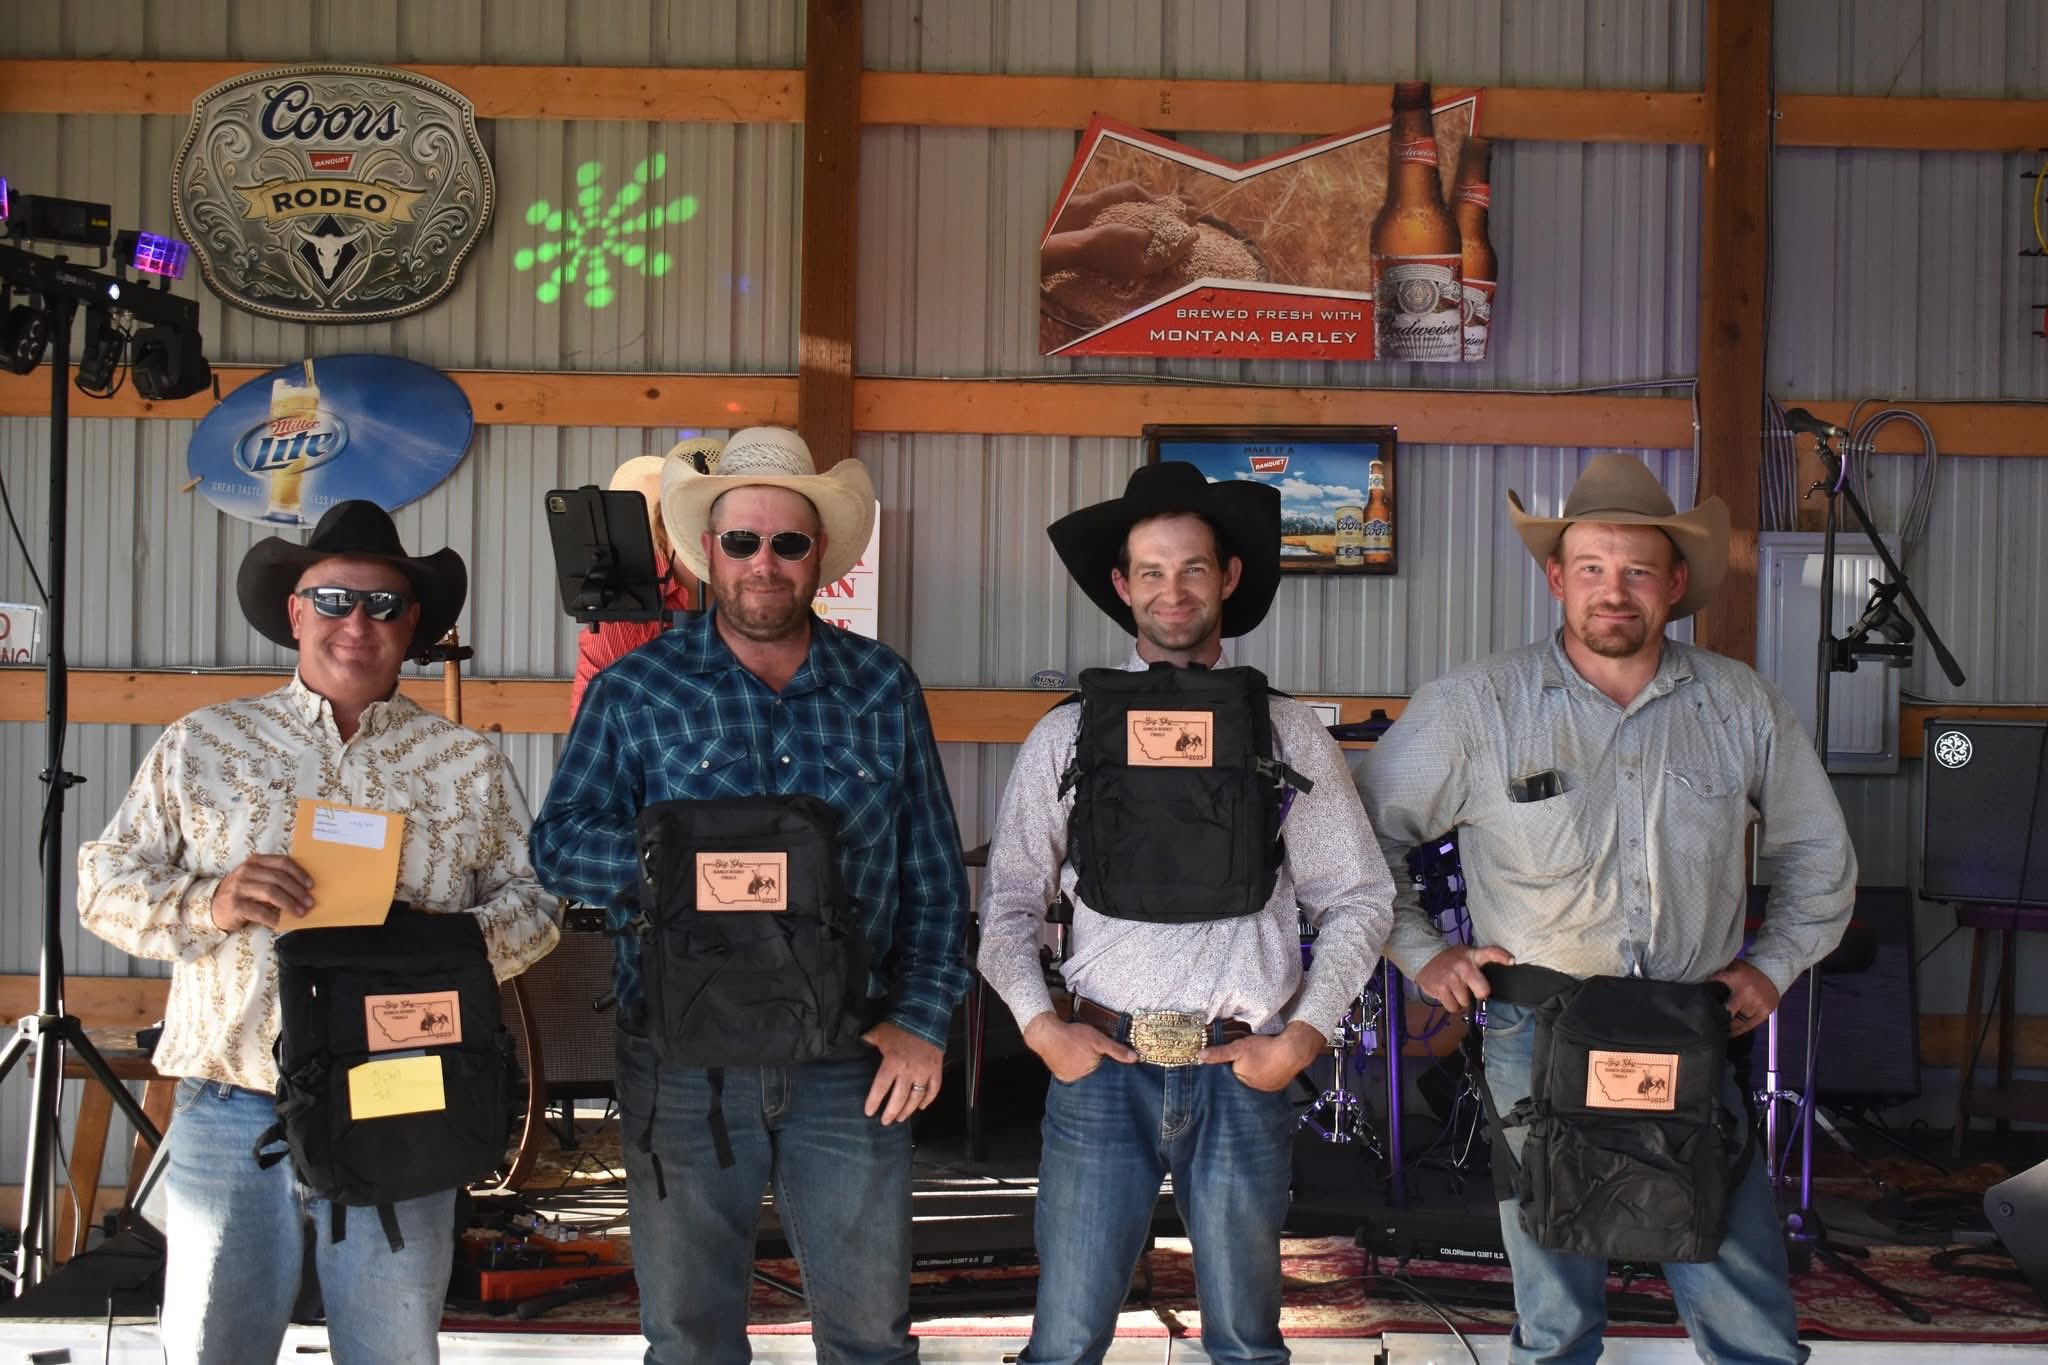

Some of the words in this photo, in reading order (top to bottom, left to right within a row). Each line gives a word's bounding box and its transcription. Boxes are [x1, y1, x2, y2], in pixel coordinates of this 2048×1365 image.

[261, 84, 404, 141] Coors
[314, 156, 350, 168] BANQUET
[271, 188, 387, 214] RODEO
[1176, 309, 1249, 320] BREWED
[1256, 309, 1313, 321] FRESH
[1320, 310, 1362, 321] WITH
[1149, 329, 1260, 343] MONTANA
[1270, 331, 1357, 344] BARLEY
[272, 418, 321, 437] Miller
[250, 430, 333, 472] Lite
[1243, 446, 1268, 455] MAKE
[1274, 447, 1286, 455] IT
[1255, 459, 1285, 470] BANQUET
[211, 482, 236, 493] GREAT
[1034, 676, 1065, 686] BUSCH
[1145, 716, 1157, 726] Big
[1159, 716, 1172, 726] Sky
[715, 859, 728, 868] Big
[730, 859, 744, 868] Sky
[384, 1000, 399, 1009] Big
[400, 999, 415, 1008] Sky
[1146, 1054, 1188, 1063] CHAMPION
[1607, 1058, 1620, 1067] Big
[1622, 1058, 1635, 1067] Sky
[1440, 1248, 1476, 1256] COLORband
